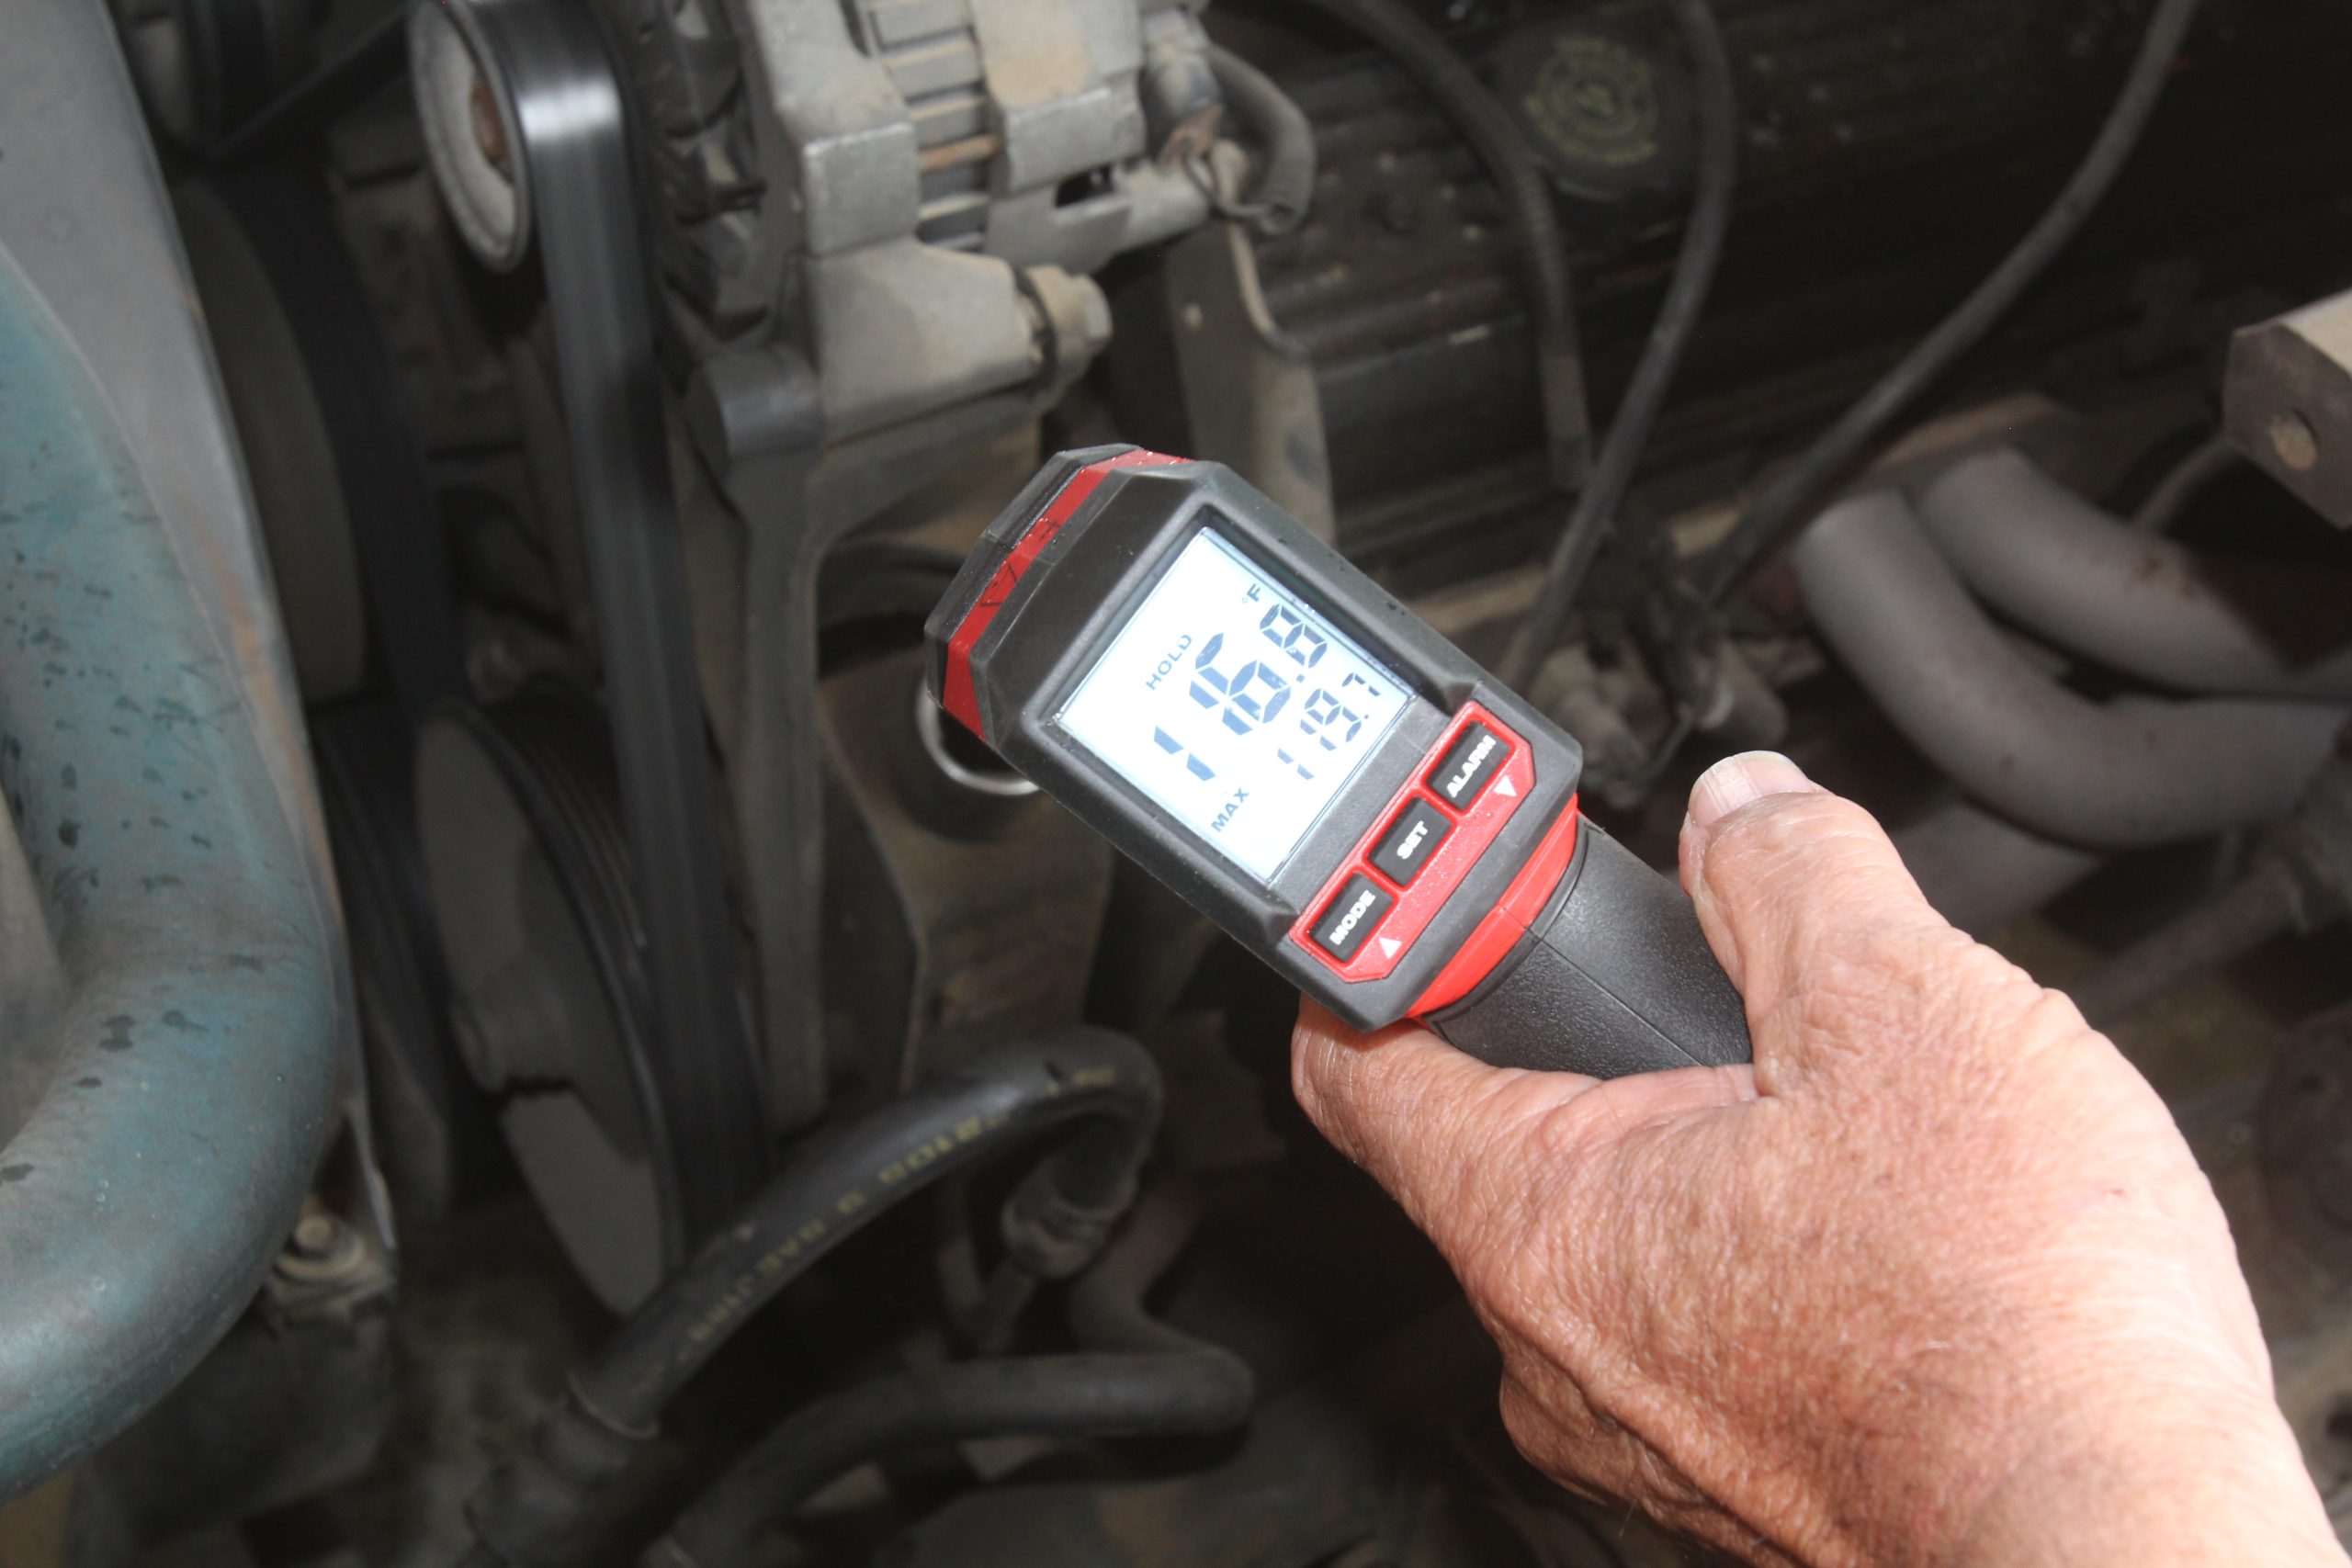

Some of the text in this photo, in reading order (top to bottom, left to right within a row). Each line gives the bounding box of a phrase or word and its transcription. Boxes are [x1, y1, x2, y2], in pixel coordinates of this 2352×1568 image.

[1146, 634, 1192, 690] HOLD
[1153, 603, 1328, 782] 116.8
[1277, 672, 1381, 780] 119.7
[1445, 734, 1497, 798] ALARM
[1210, 787, 1250, 832] MAX
[1396, 820, 1428, 859] SET
[1329, 889, 1375, 945] MODE
